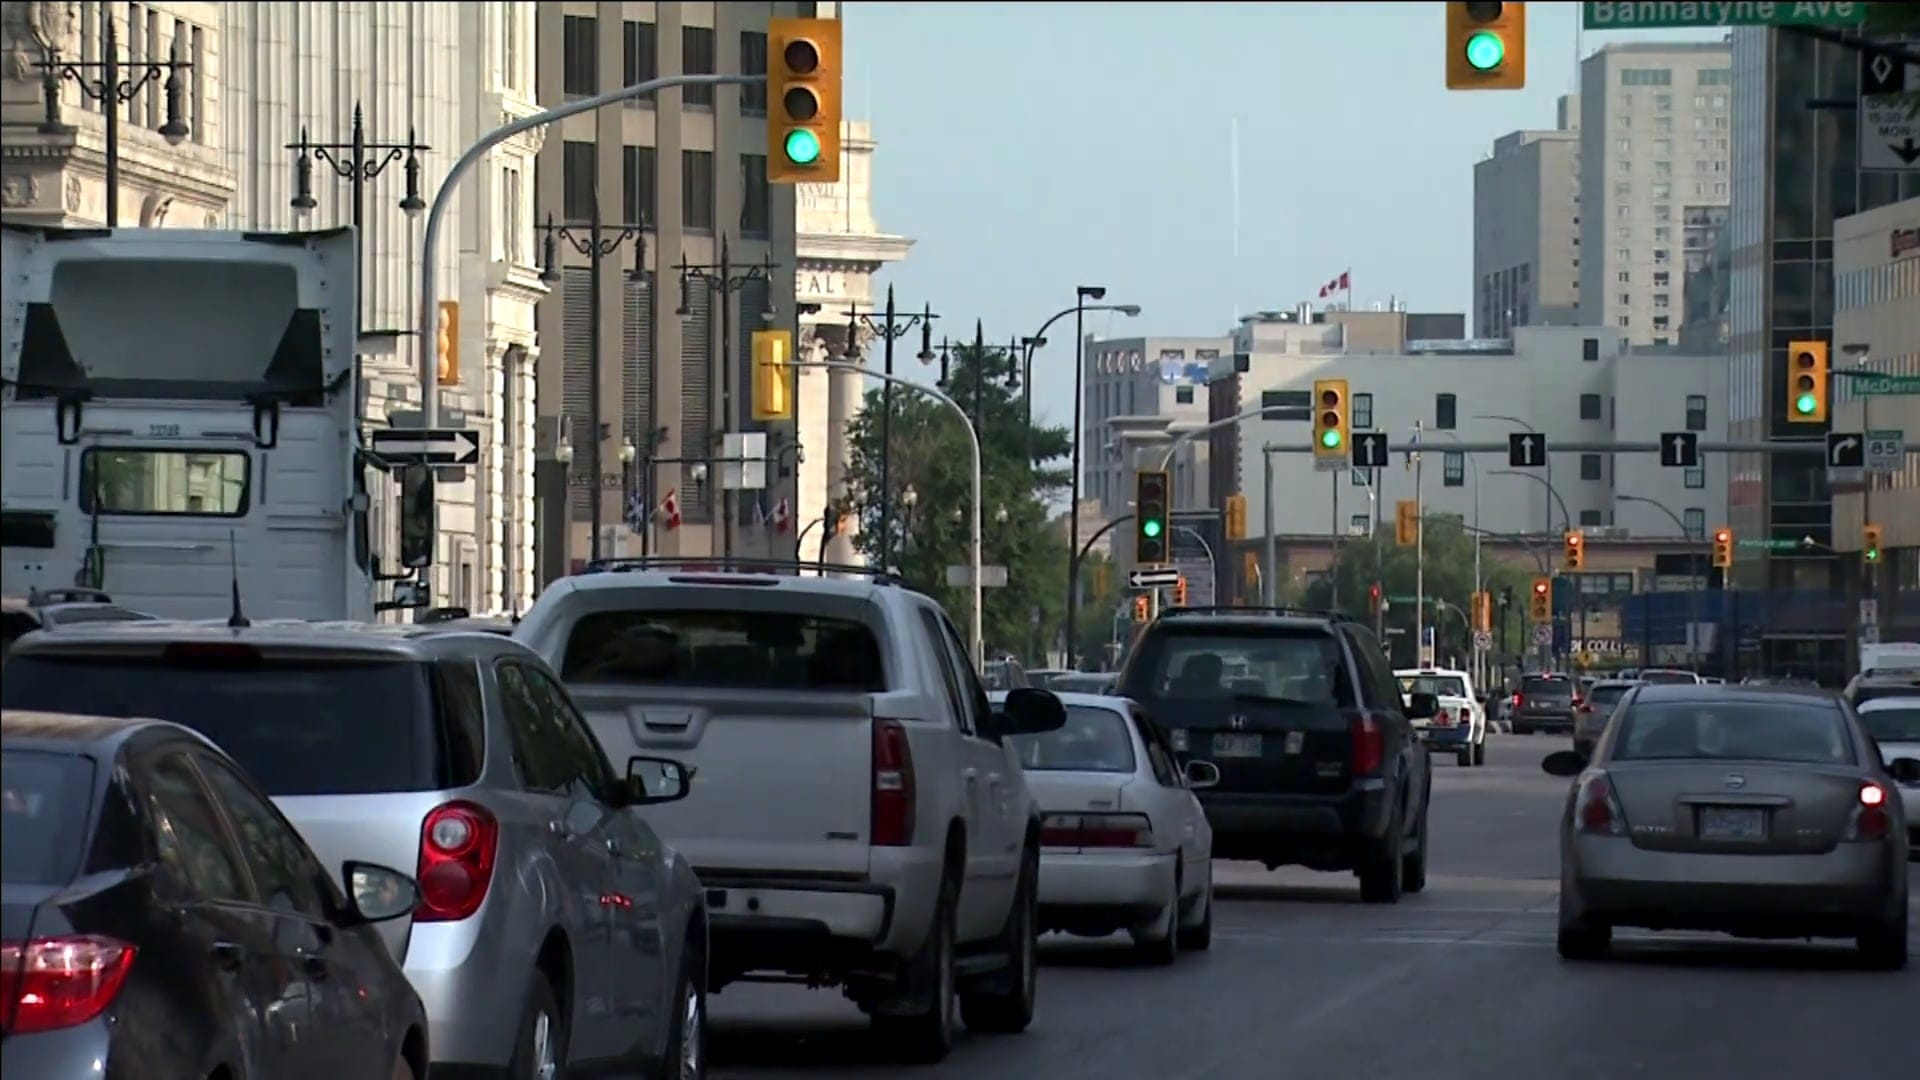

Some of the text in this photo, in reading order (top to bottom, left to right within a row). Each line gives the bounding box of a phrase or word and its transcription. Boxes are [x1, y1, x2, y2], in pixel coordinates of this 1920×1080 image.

[1594, 1, 1853, 25] Bannatyne Ave
[1872, 441, 1897, 455] 85
[1586, 639, 1622, 654] COLL
